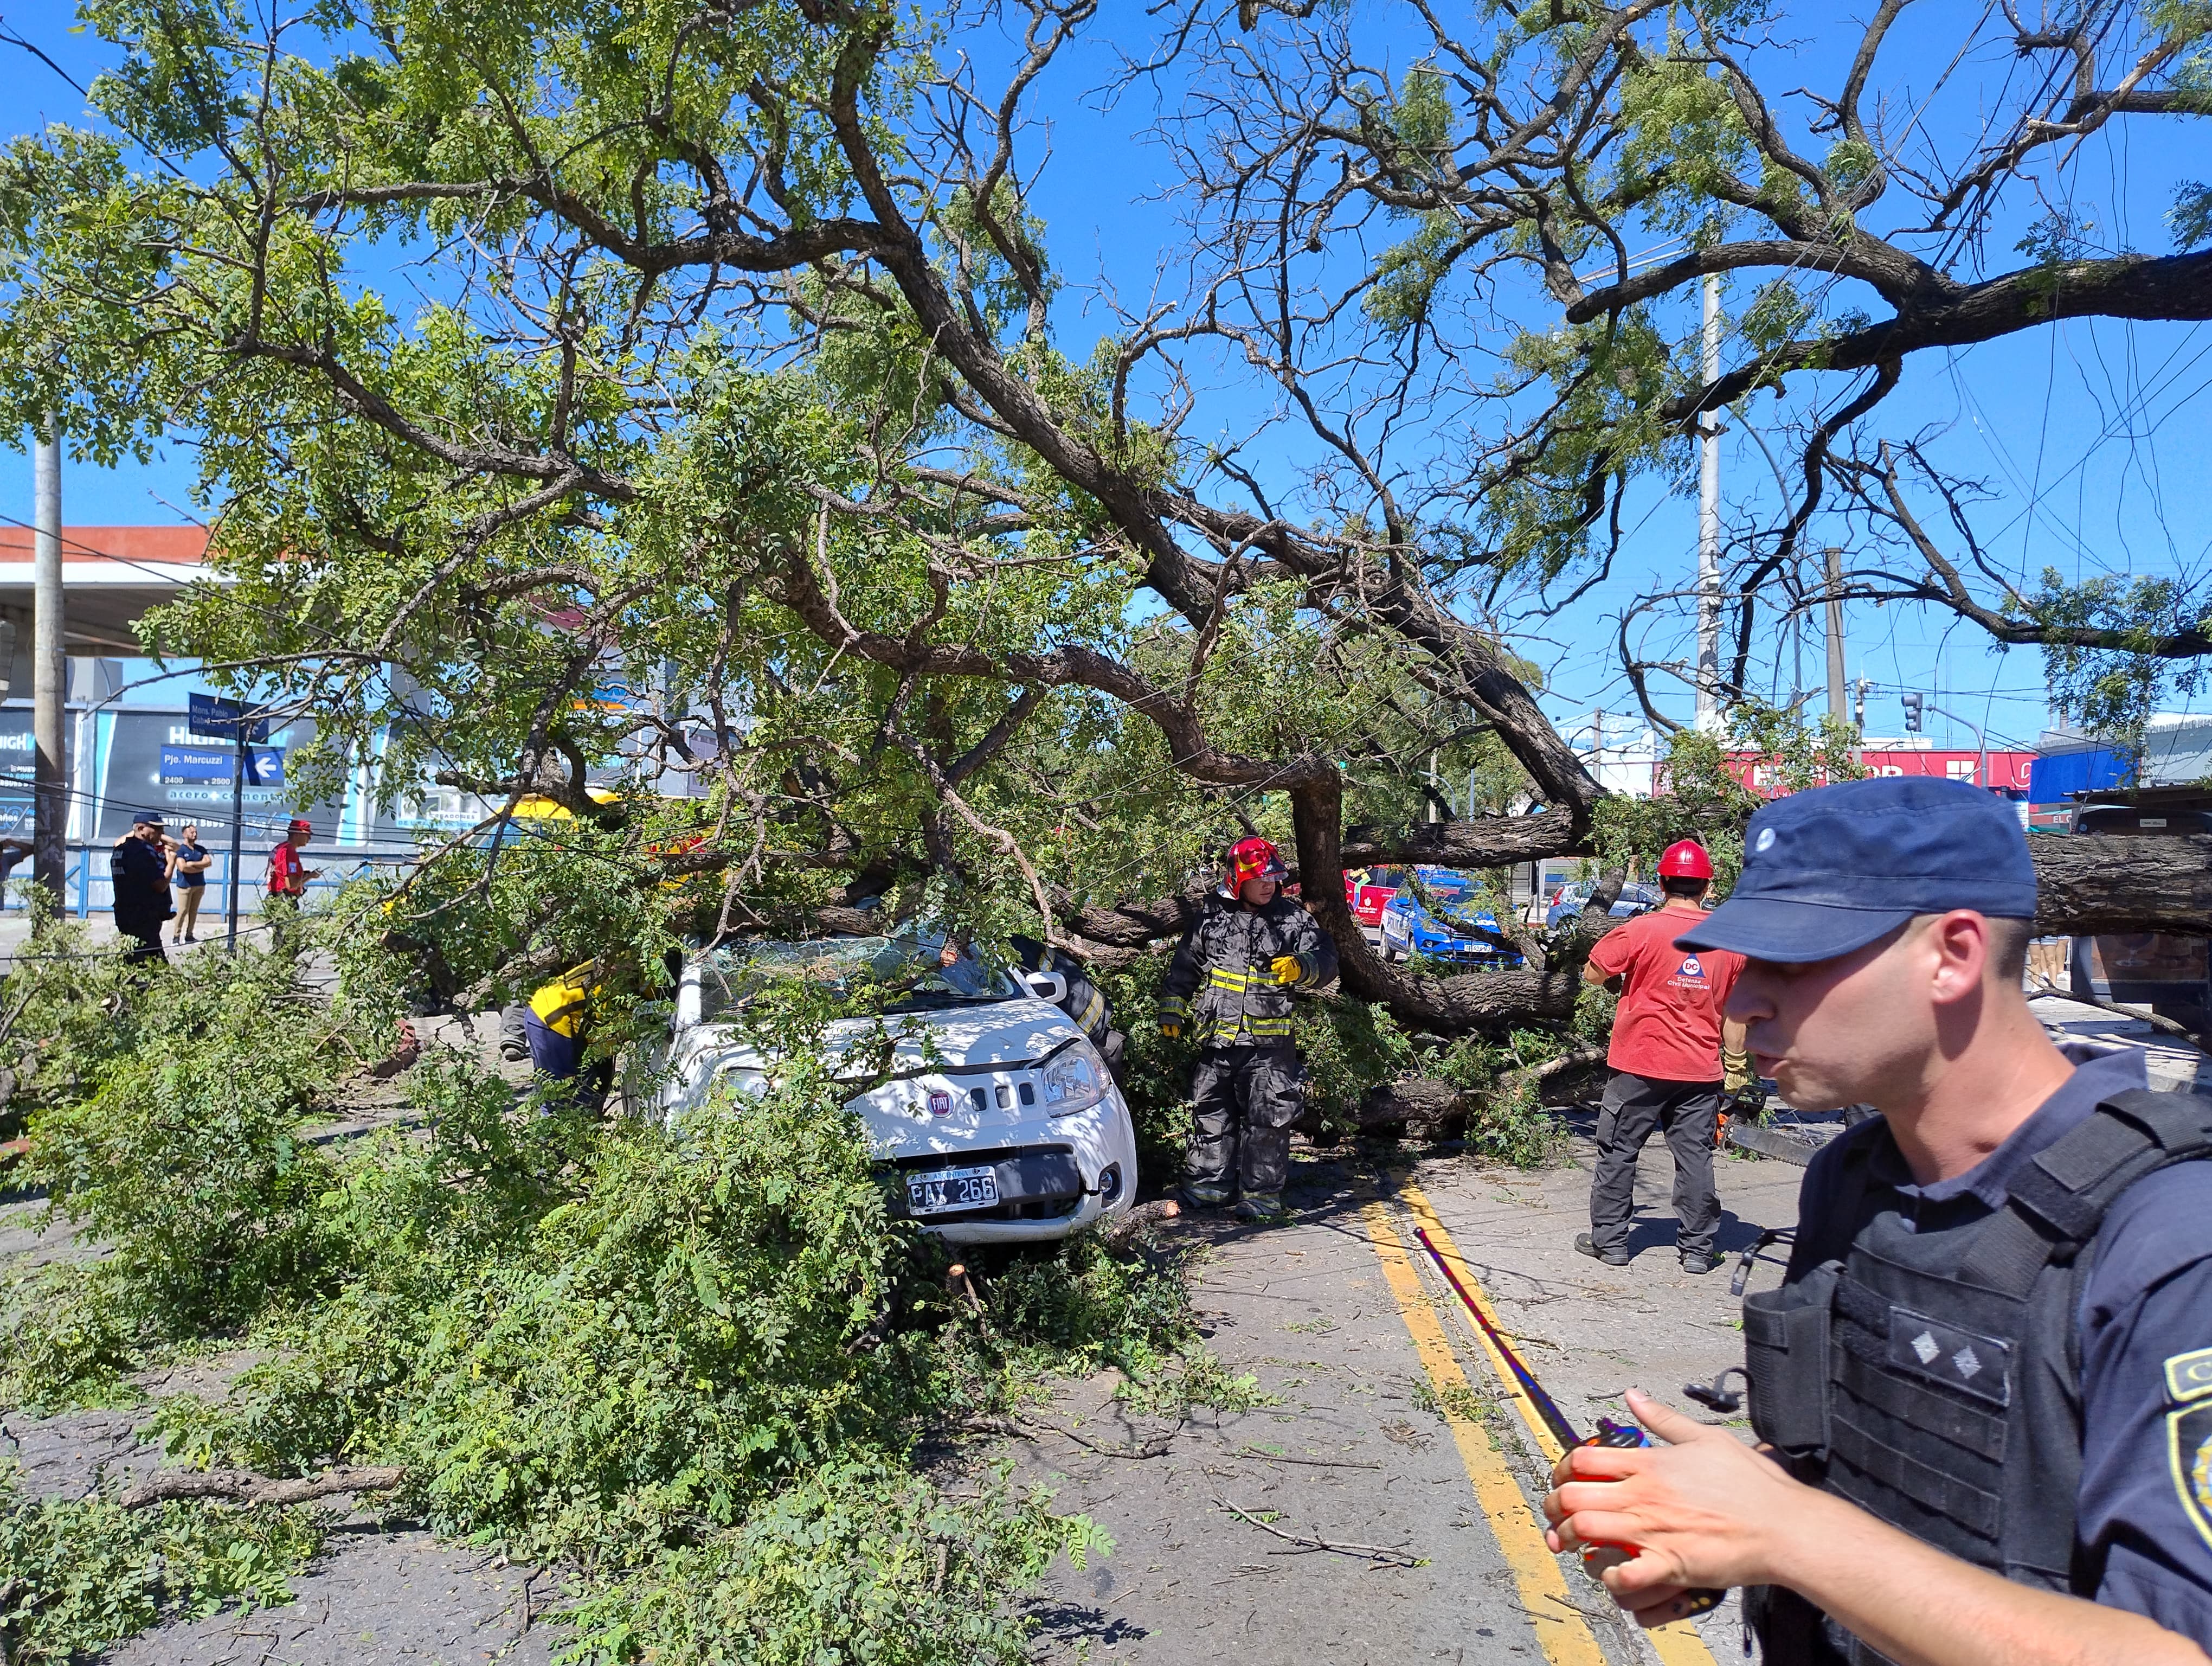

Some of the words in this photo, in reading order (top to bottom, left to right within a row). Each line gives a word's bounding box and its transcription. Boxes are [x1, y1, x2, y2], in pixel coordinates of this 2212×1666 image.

[211, 707, 228, 718] Pablo
[1558, 726, 1594, 740] TIGR
[164, 754, 181, 766] Pje.
[164, 776, 184, 784] 2400
[211, 777, 231, 785] 2500
[169, 790, 209, 799] acero
[1685, 963, 1698, 971] DC
[932, 1097, 949, 1111] FIAT
[933, 1170, 968, 1181] ARGENTINA
[958, 1177, 995, 1202] 266
